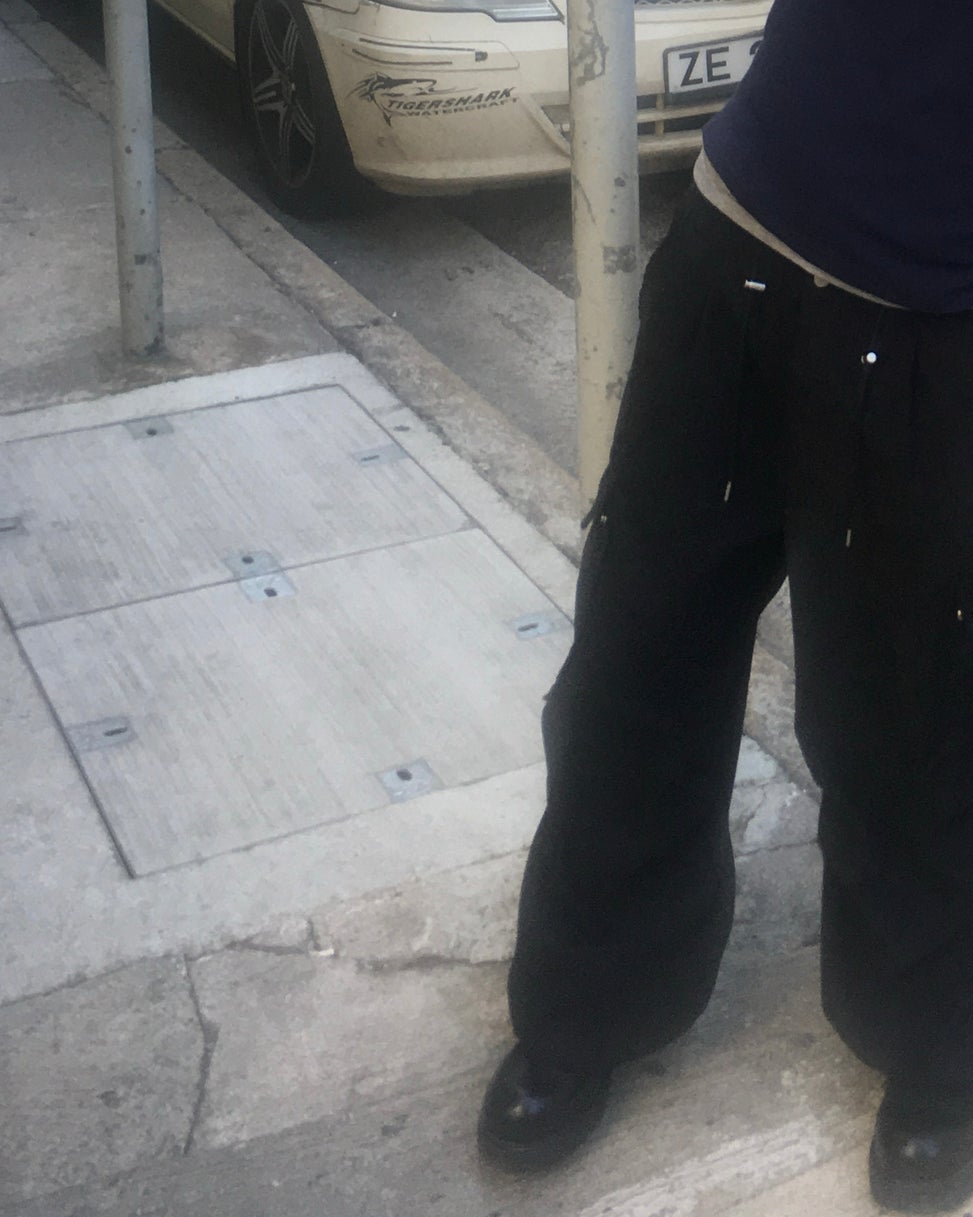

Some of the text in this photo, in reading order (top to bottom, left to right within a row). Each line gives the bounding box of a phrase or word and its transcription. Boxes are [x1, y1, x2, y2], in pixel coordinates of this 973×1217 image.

[679, 46, 731, 87] ZE
[387, 87, 517, 111] TIGERSHARK
[405, 98, 519, 117] WATERCRAFT
